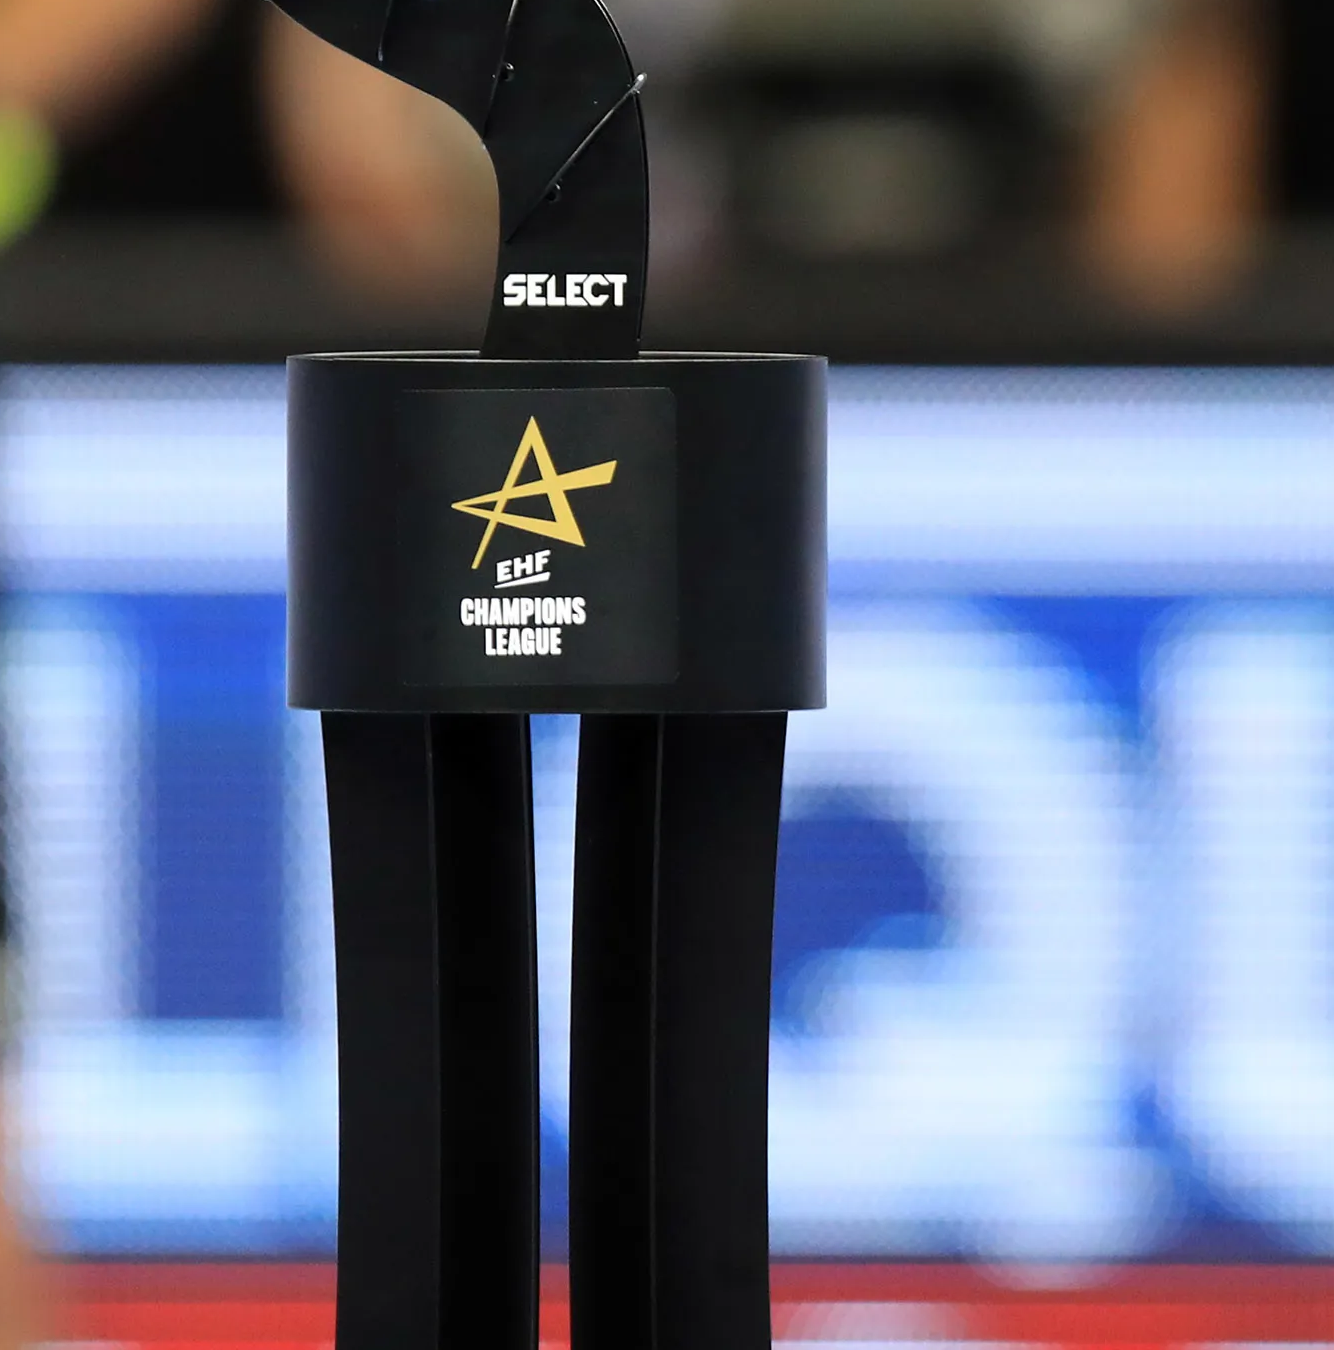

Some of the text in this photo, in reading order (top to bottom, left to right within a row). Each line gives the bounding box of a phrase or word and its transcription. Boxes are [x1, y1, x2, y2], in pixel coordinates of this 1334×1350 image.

[503, 273, 627, 307] SELECT
[496, 550, 551, 583] EHF
[460, 597, 586, 626] CHAMPIONS
[485, 627, 562, 656] LEAGUE
